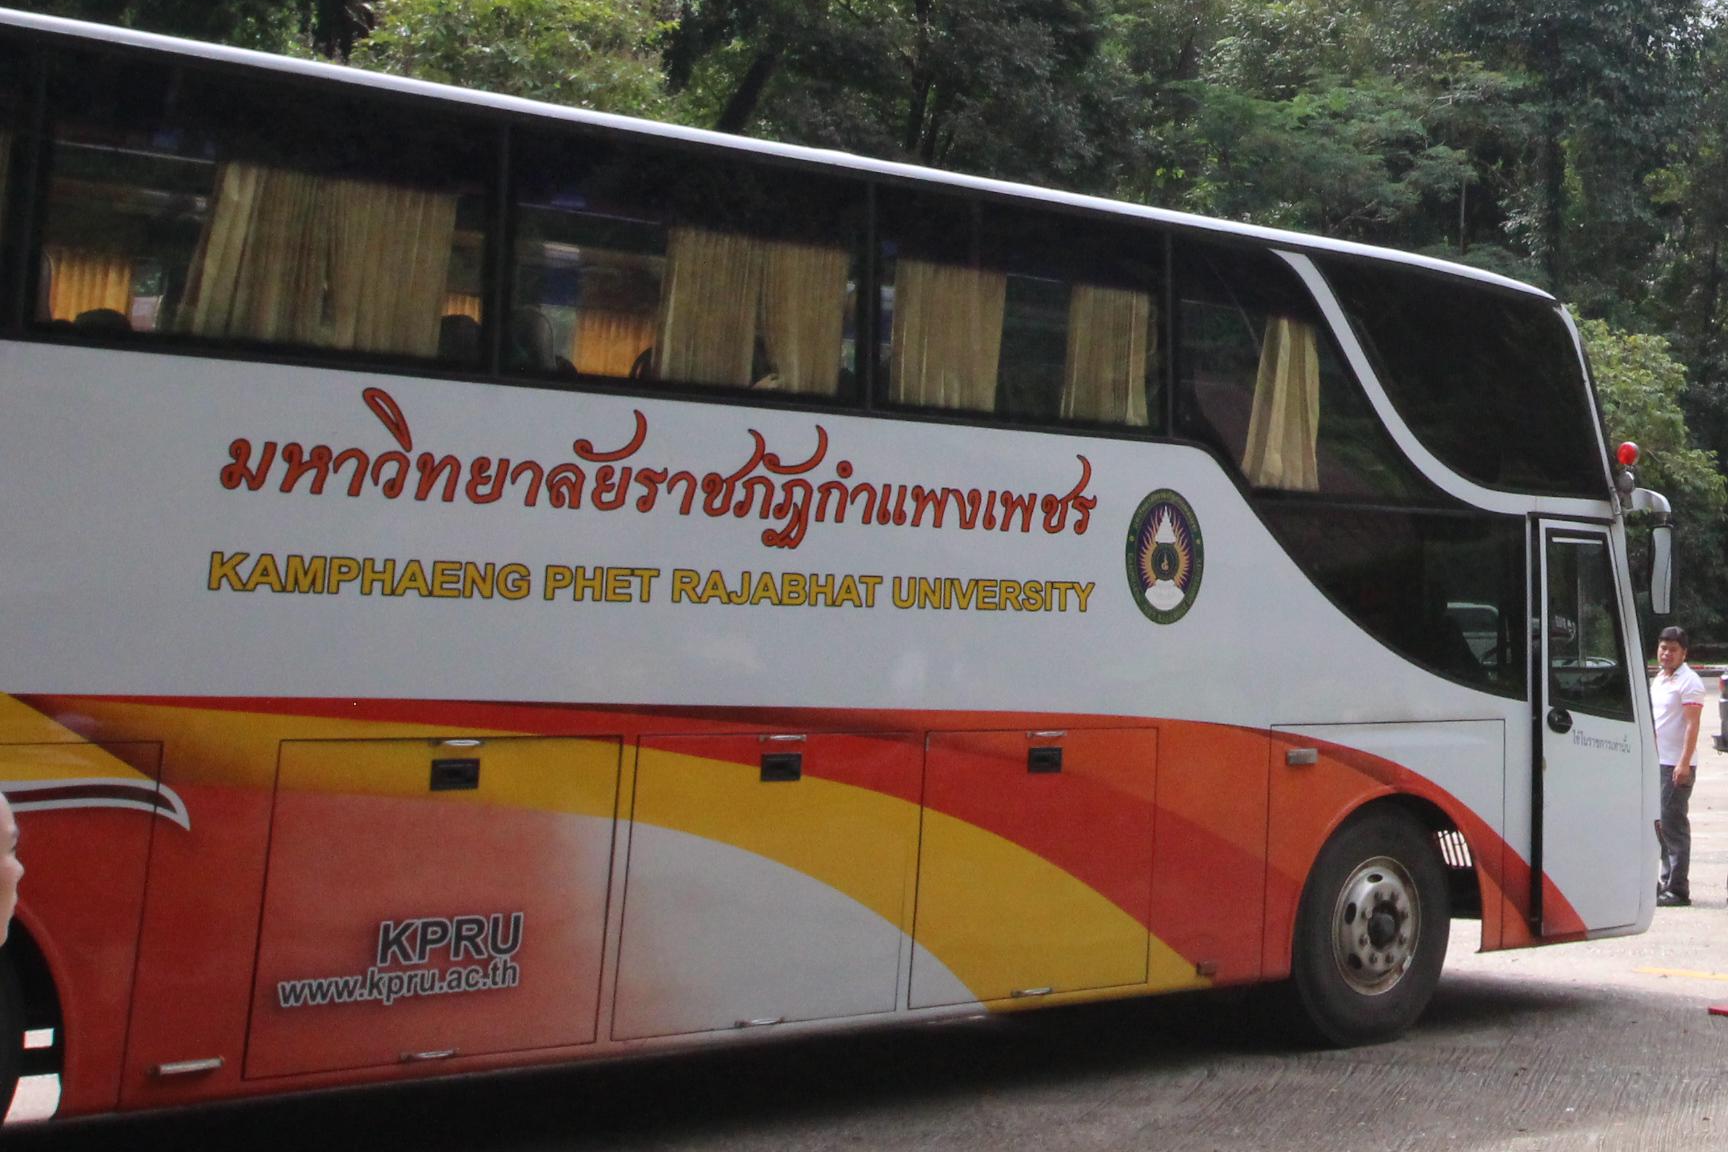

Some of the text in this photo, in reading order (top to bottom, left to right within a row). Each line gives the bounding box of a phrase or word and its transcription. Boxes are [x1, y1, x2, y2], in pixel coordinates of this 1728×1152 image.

[220, 387, 1097, 549] มหาวิทยาลัยราชภัฏกำแพงเพชร
[207, 551, 531, 599] KAMPHAENG
[544, 565, 660, 602] PHET
[671, 569, 883, 608] RAJABHAT
[892, 577, 1096, 612] UNIVERSITY
[377, 911, 524, 967] KPRU
[277, 958, 519, 1007] www.kpru.ac.th
